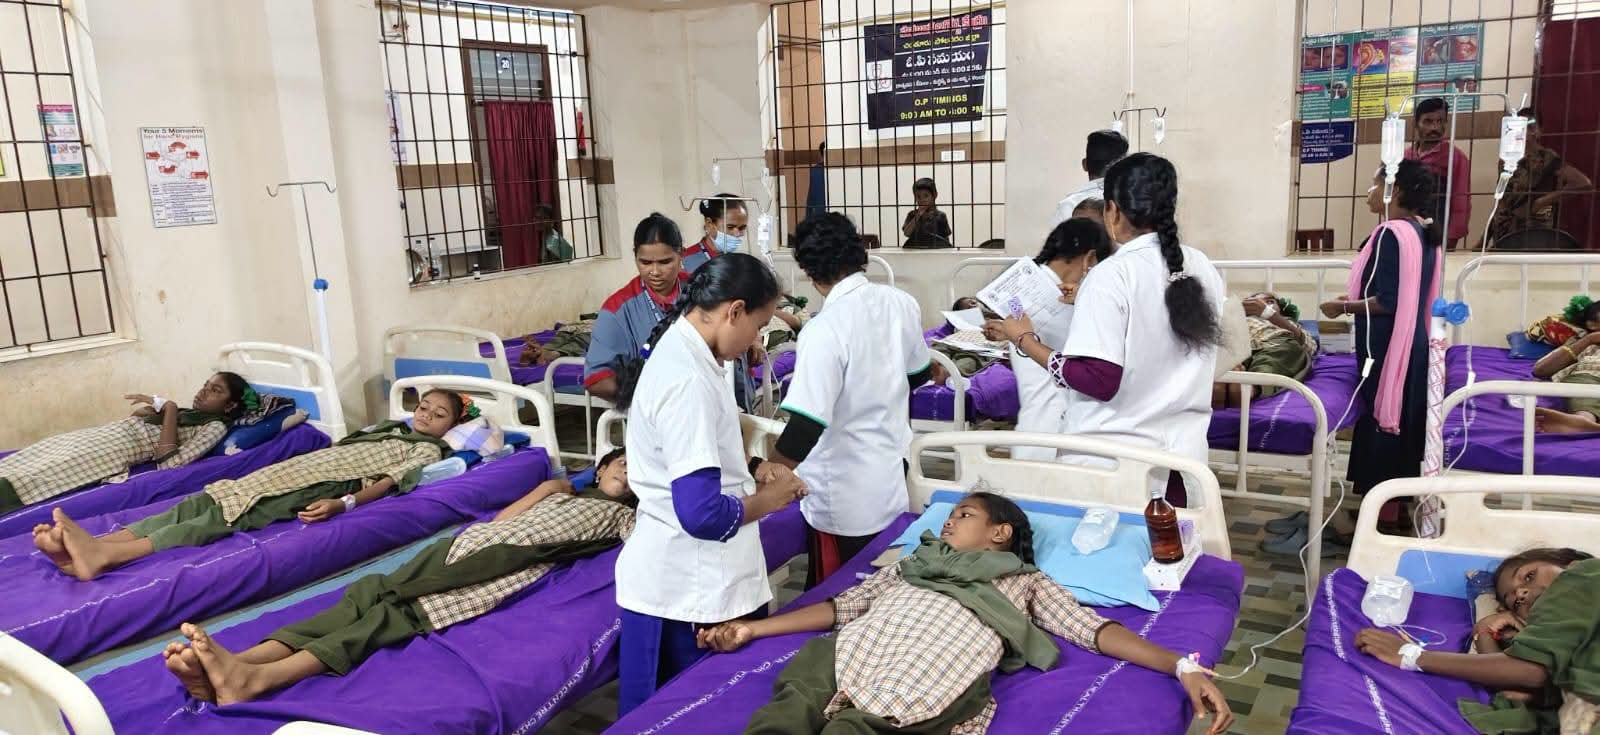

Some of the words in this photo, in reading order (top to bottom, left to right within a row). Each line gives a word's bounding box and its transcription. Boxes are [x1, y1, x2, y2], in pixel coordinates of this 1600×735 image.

[502, 60, 510, 69] 20
[920, 110, 933, 118] AM
[935, 109, 947, 117] TO
[537, 684, 569, 719] CENTRE
